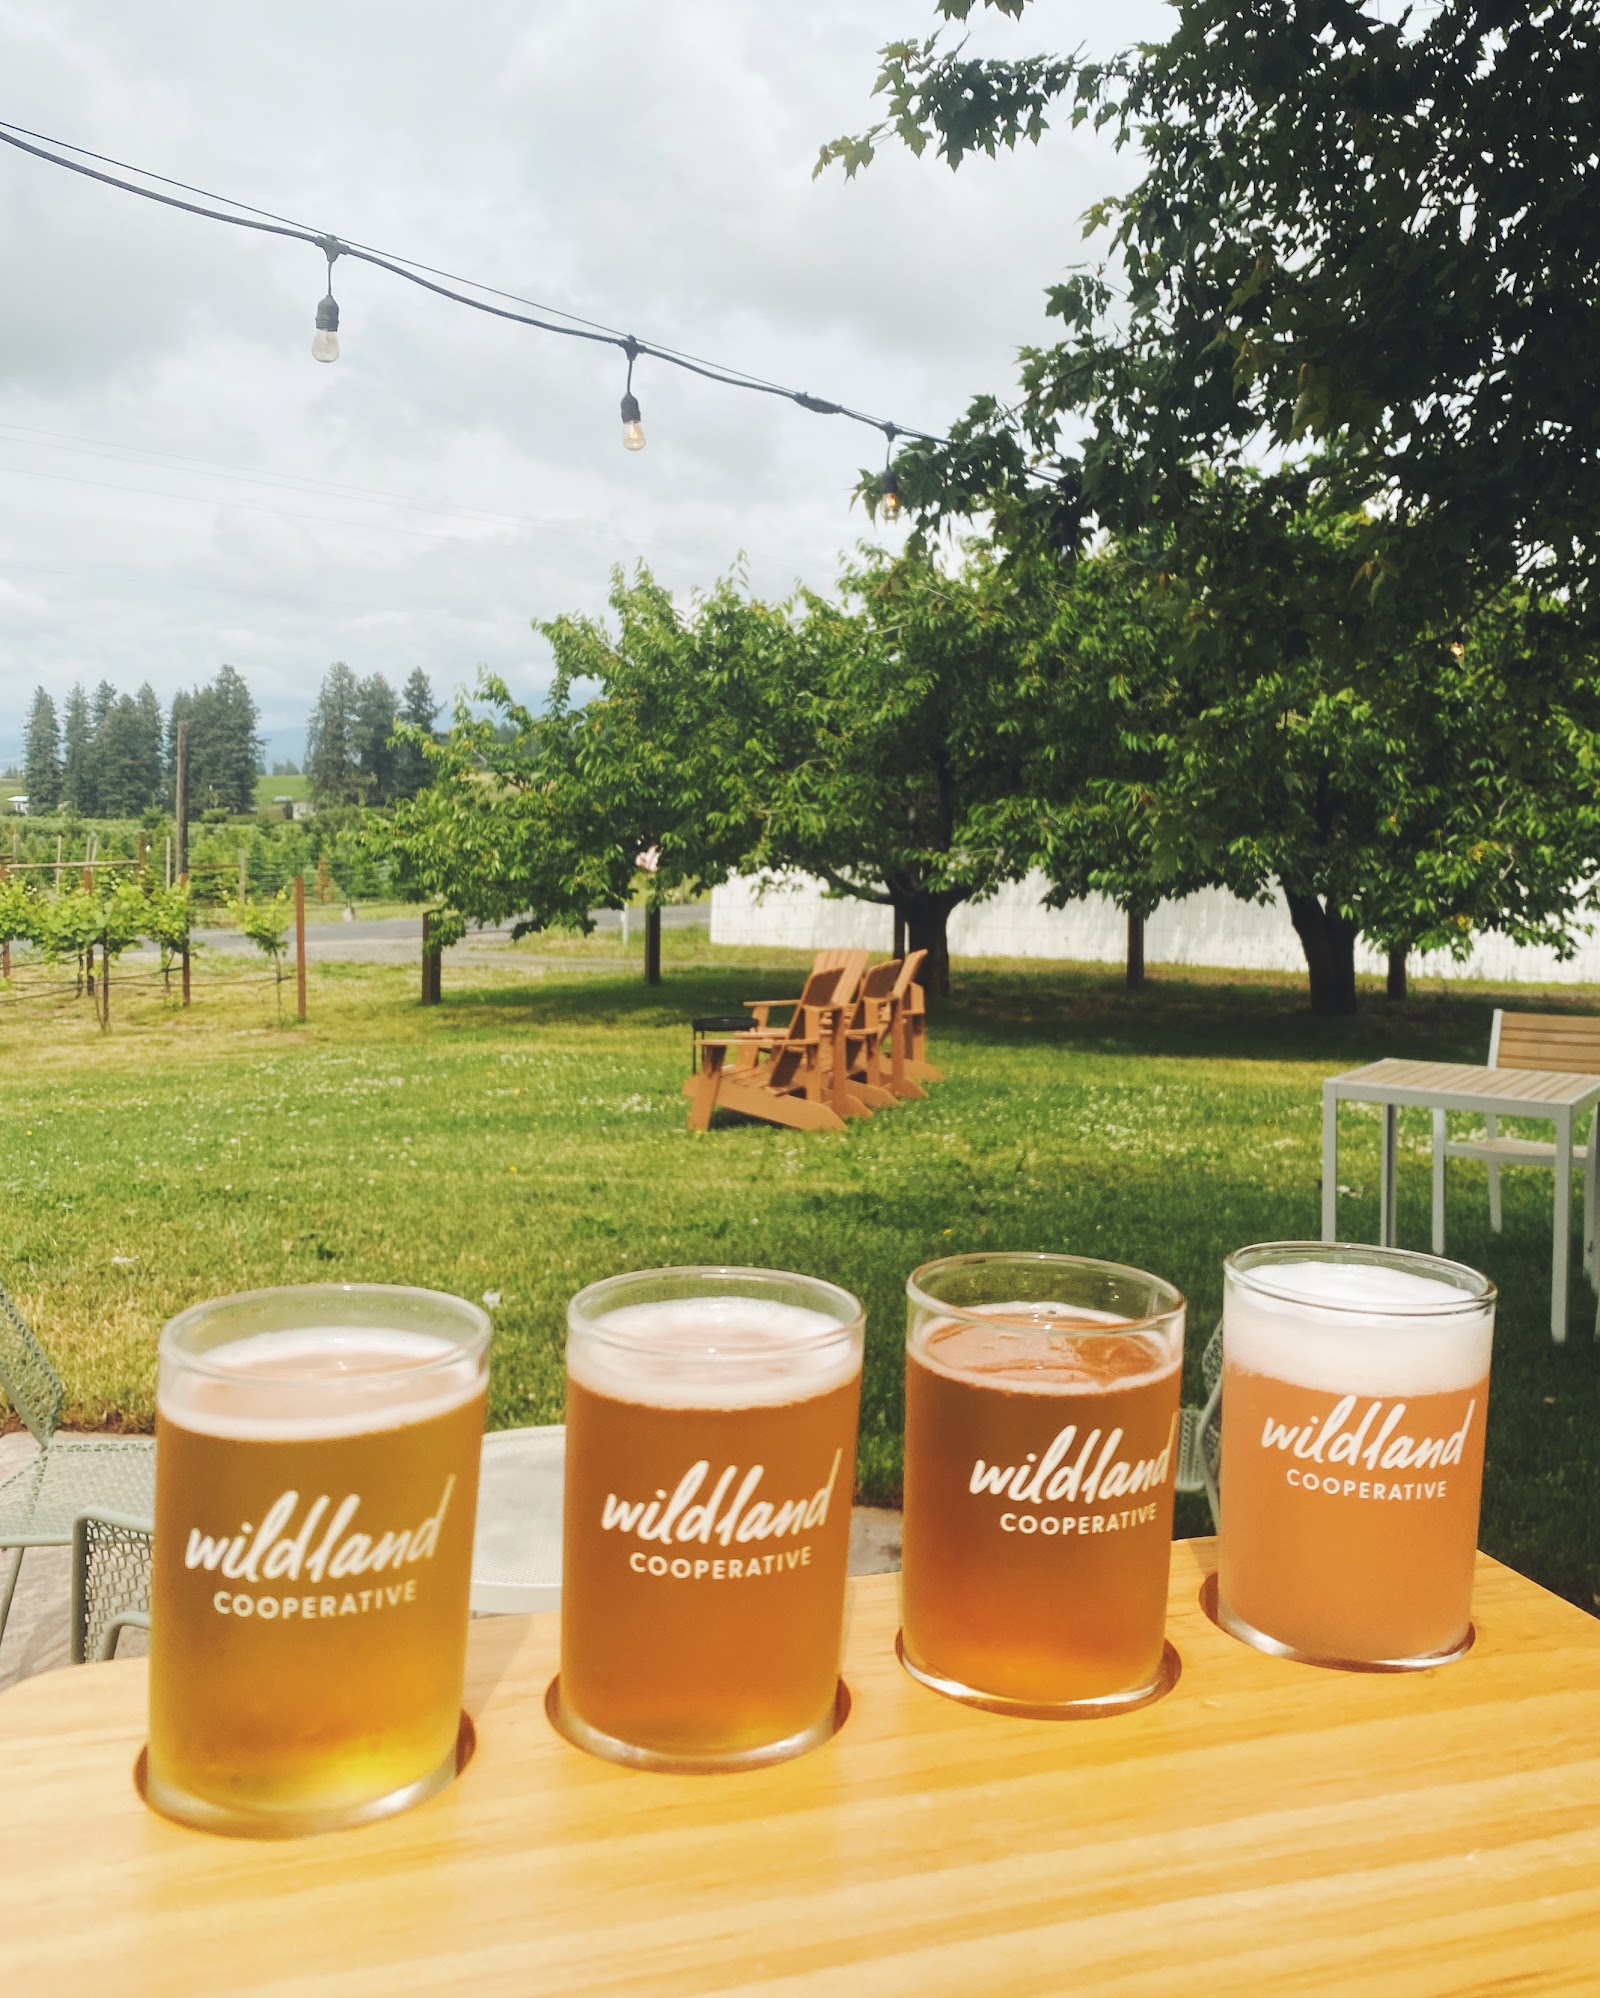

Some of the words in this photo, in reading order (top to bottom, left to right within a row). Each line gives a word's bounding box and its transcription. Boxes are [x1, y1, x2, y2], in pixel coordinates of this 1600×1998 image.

[969, 1411, 1180, 1505] wildland
[1261, 1394, 1477, 1472] wildland
[600, 1447, 844, 1546] wildland
[1286, 1468, 1448, 1501] COOPERATIVE
[184, 1473, 457, 1583] wildland
[1000, 1502, 1157, 1536] COOPERATIVE
[628, 1545, 813, 1581] COOPERATIVE
[212, 1578, 418, 1620] COOPERATIVE
